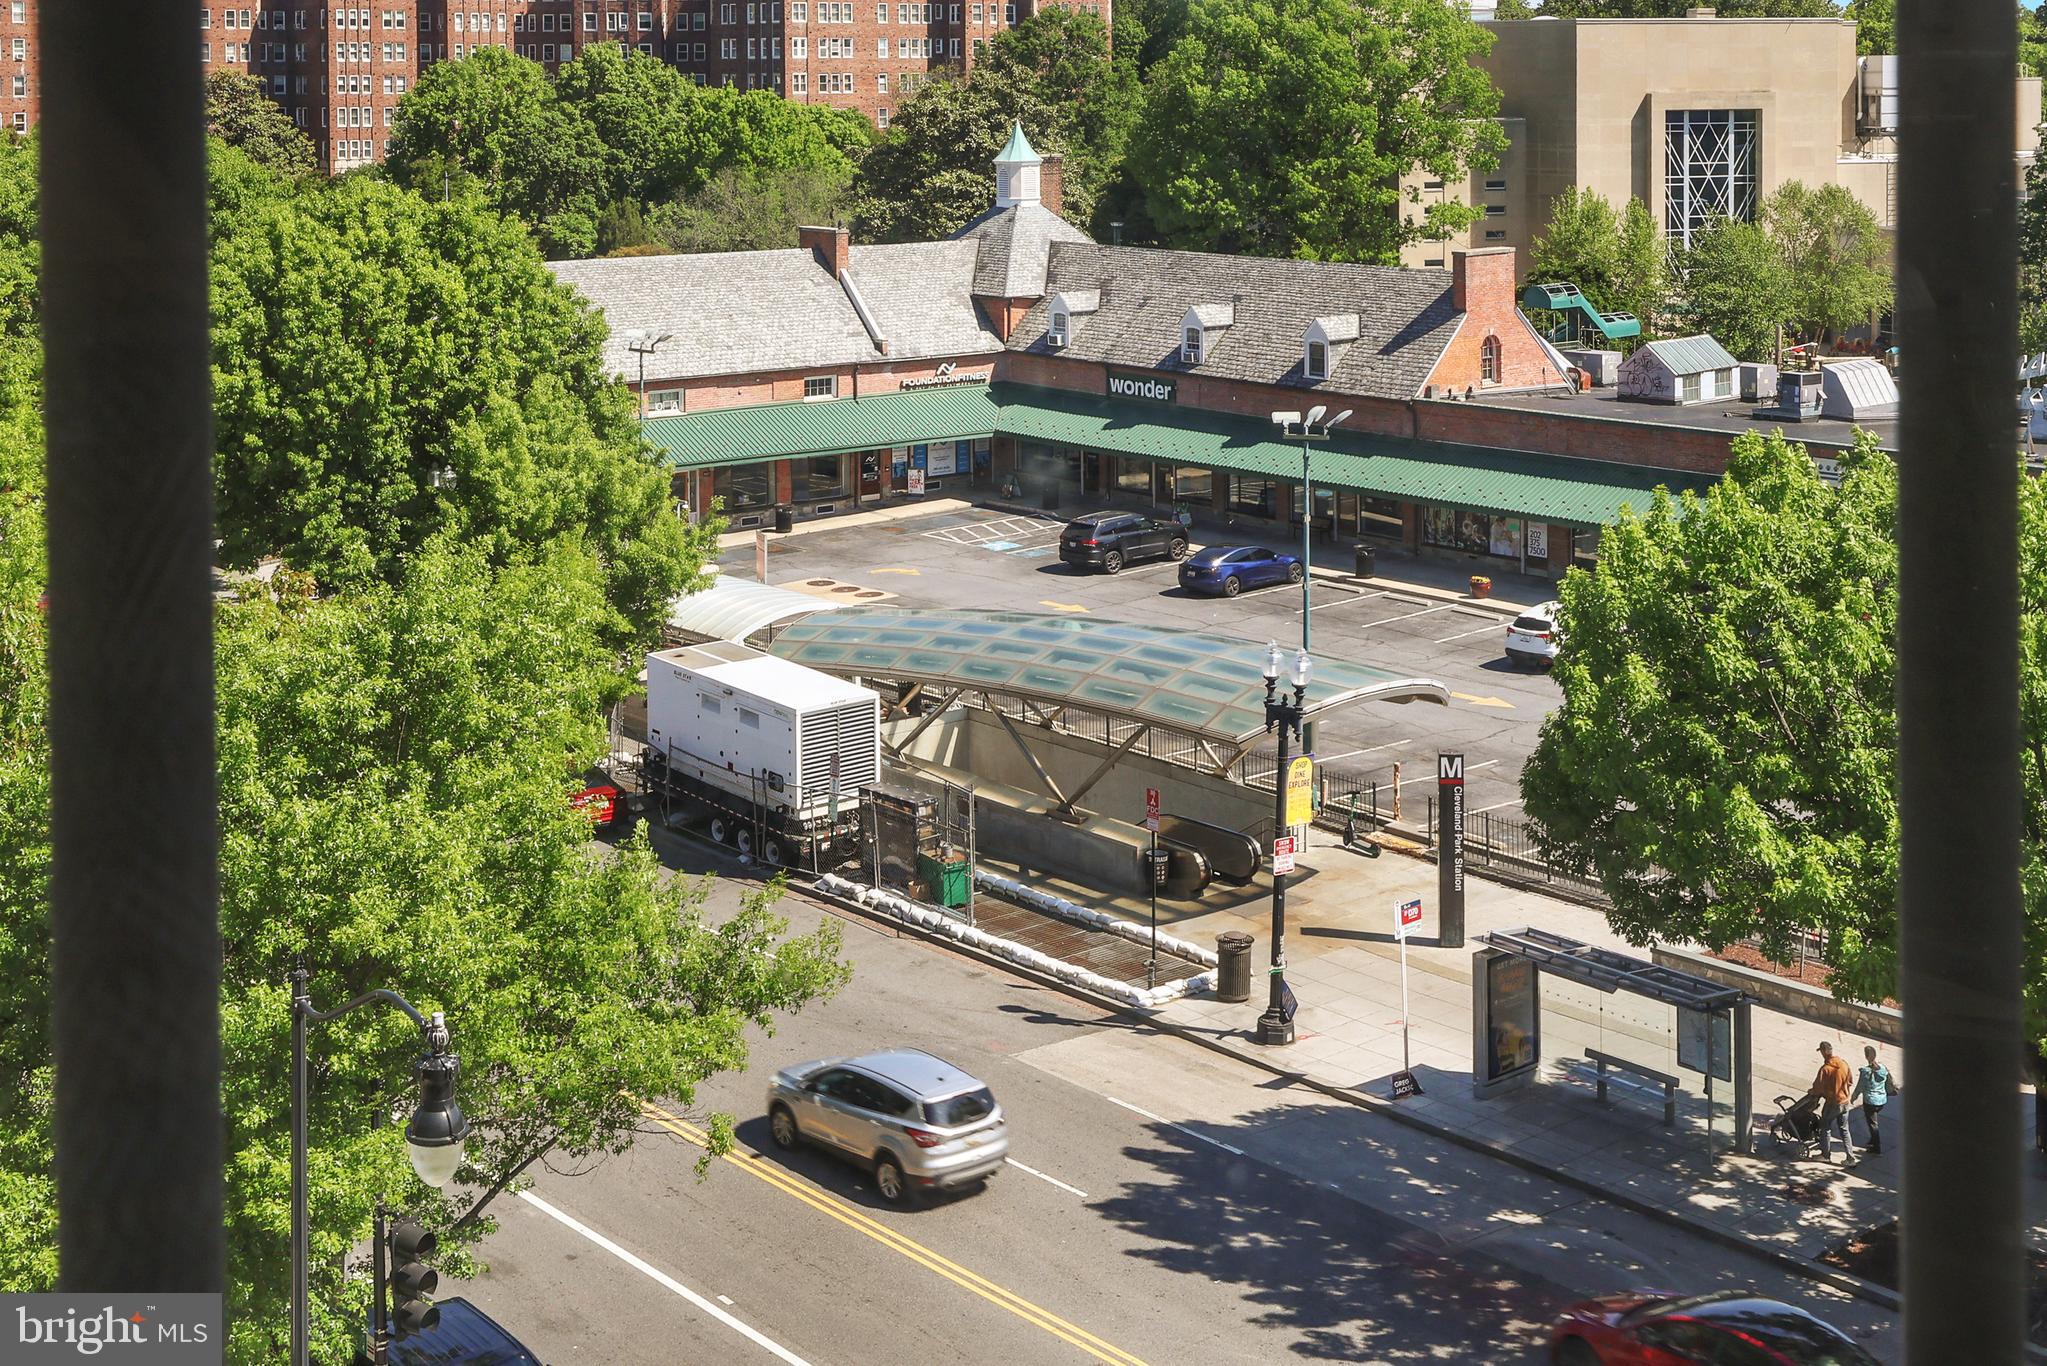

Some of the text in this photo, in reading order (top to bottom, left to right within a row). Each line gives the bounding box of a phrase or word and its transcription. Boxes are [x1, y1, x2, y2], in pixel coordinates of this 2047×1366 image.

[1109, 378, 1171, 400] wonder
[1530, 530, 1541, 539] 202
[1530, 538, 1540, 546] 375
[1529, 546, 1545, 555] 7500
[1440, 757, 1462, 778] M
[1289, 779, 1310, 789] EXPLORE
[1454, 786, 1463, 891] Cleveland Park Station
